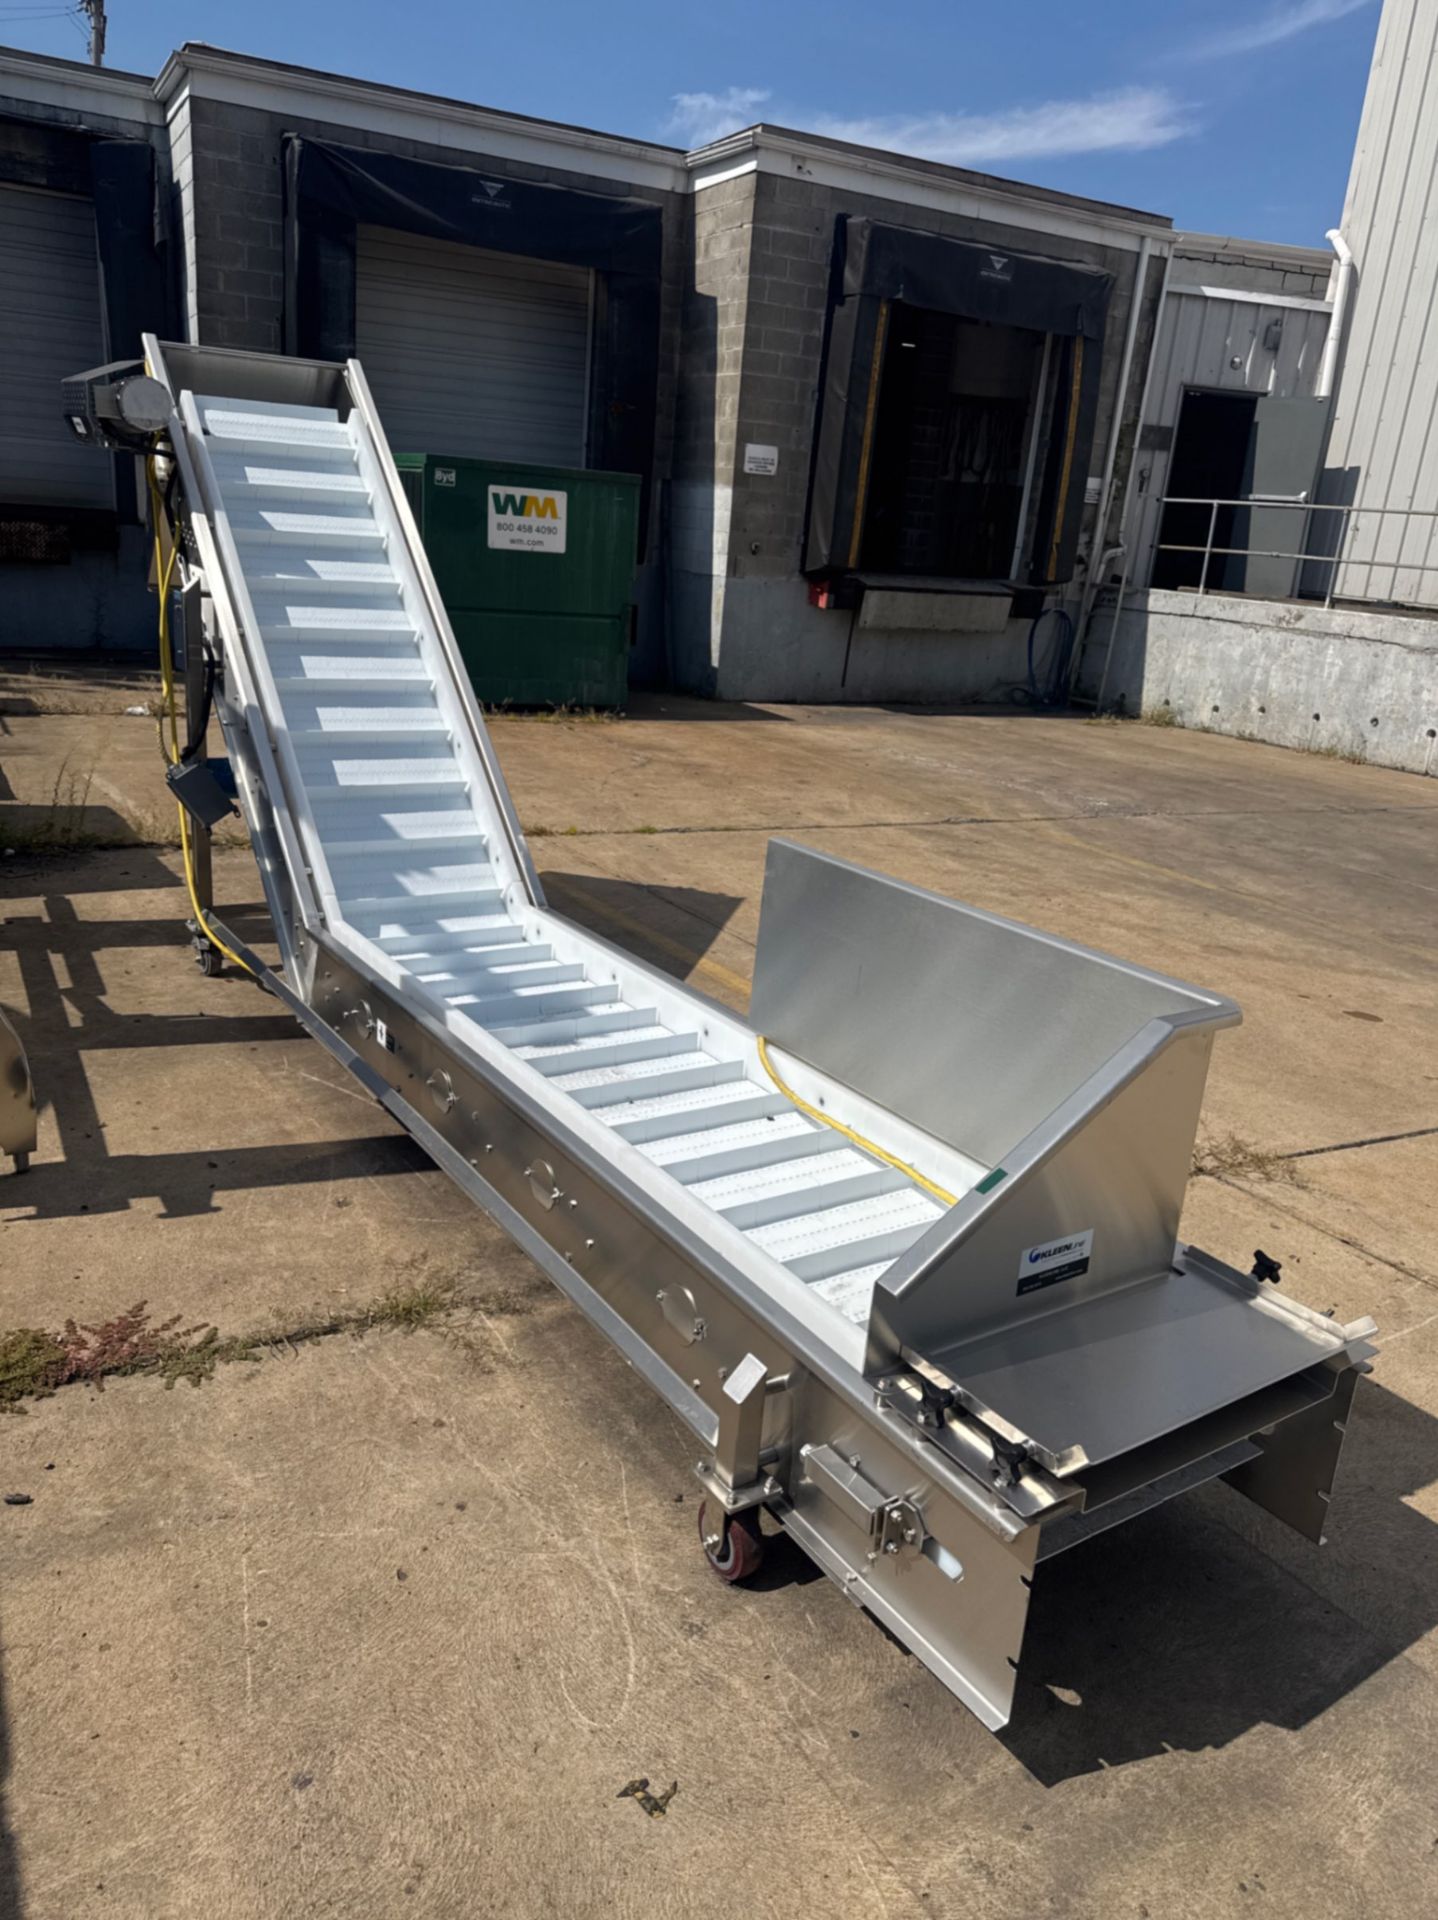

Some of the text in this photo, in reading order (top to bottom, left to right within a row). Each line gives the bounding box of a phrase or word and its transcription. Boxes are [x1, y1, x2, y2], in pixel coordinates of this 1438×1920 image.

[492, 492, 559, 520] WM
[497, 522, 558, 536] 800 458 4090
[509, 538, 545, 547] wm.com
